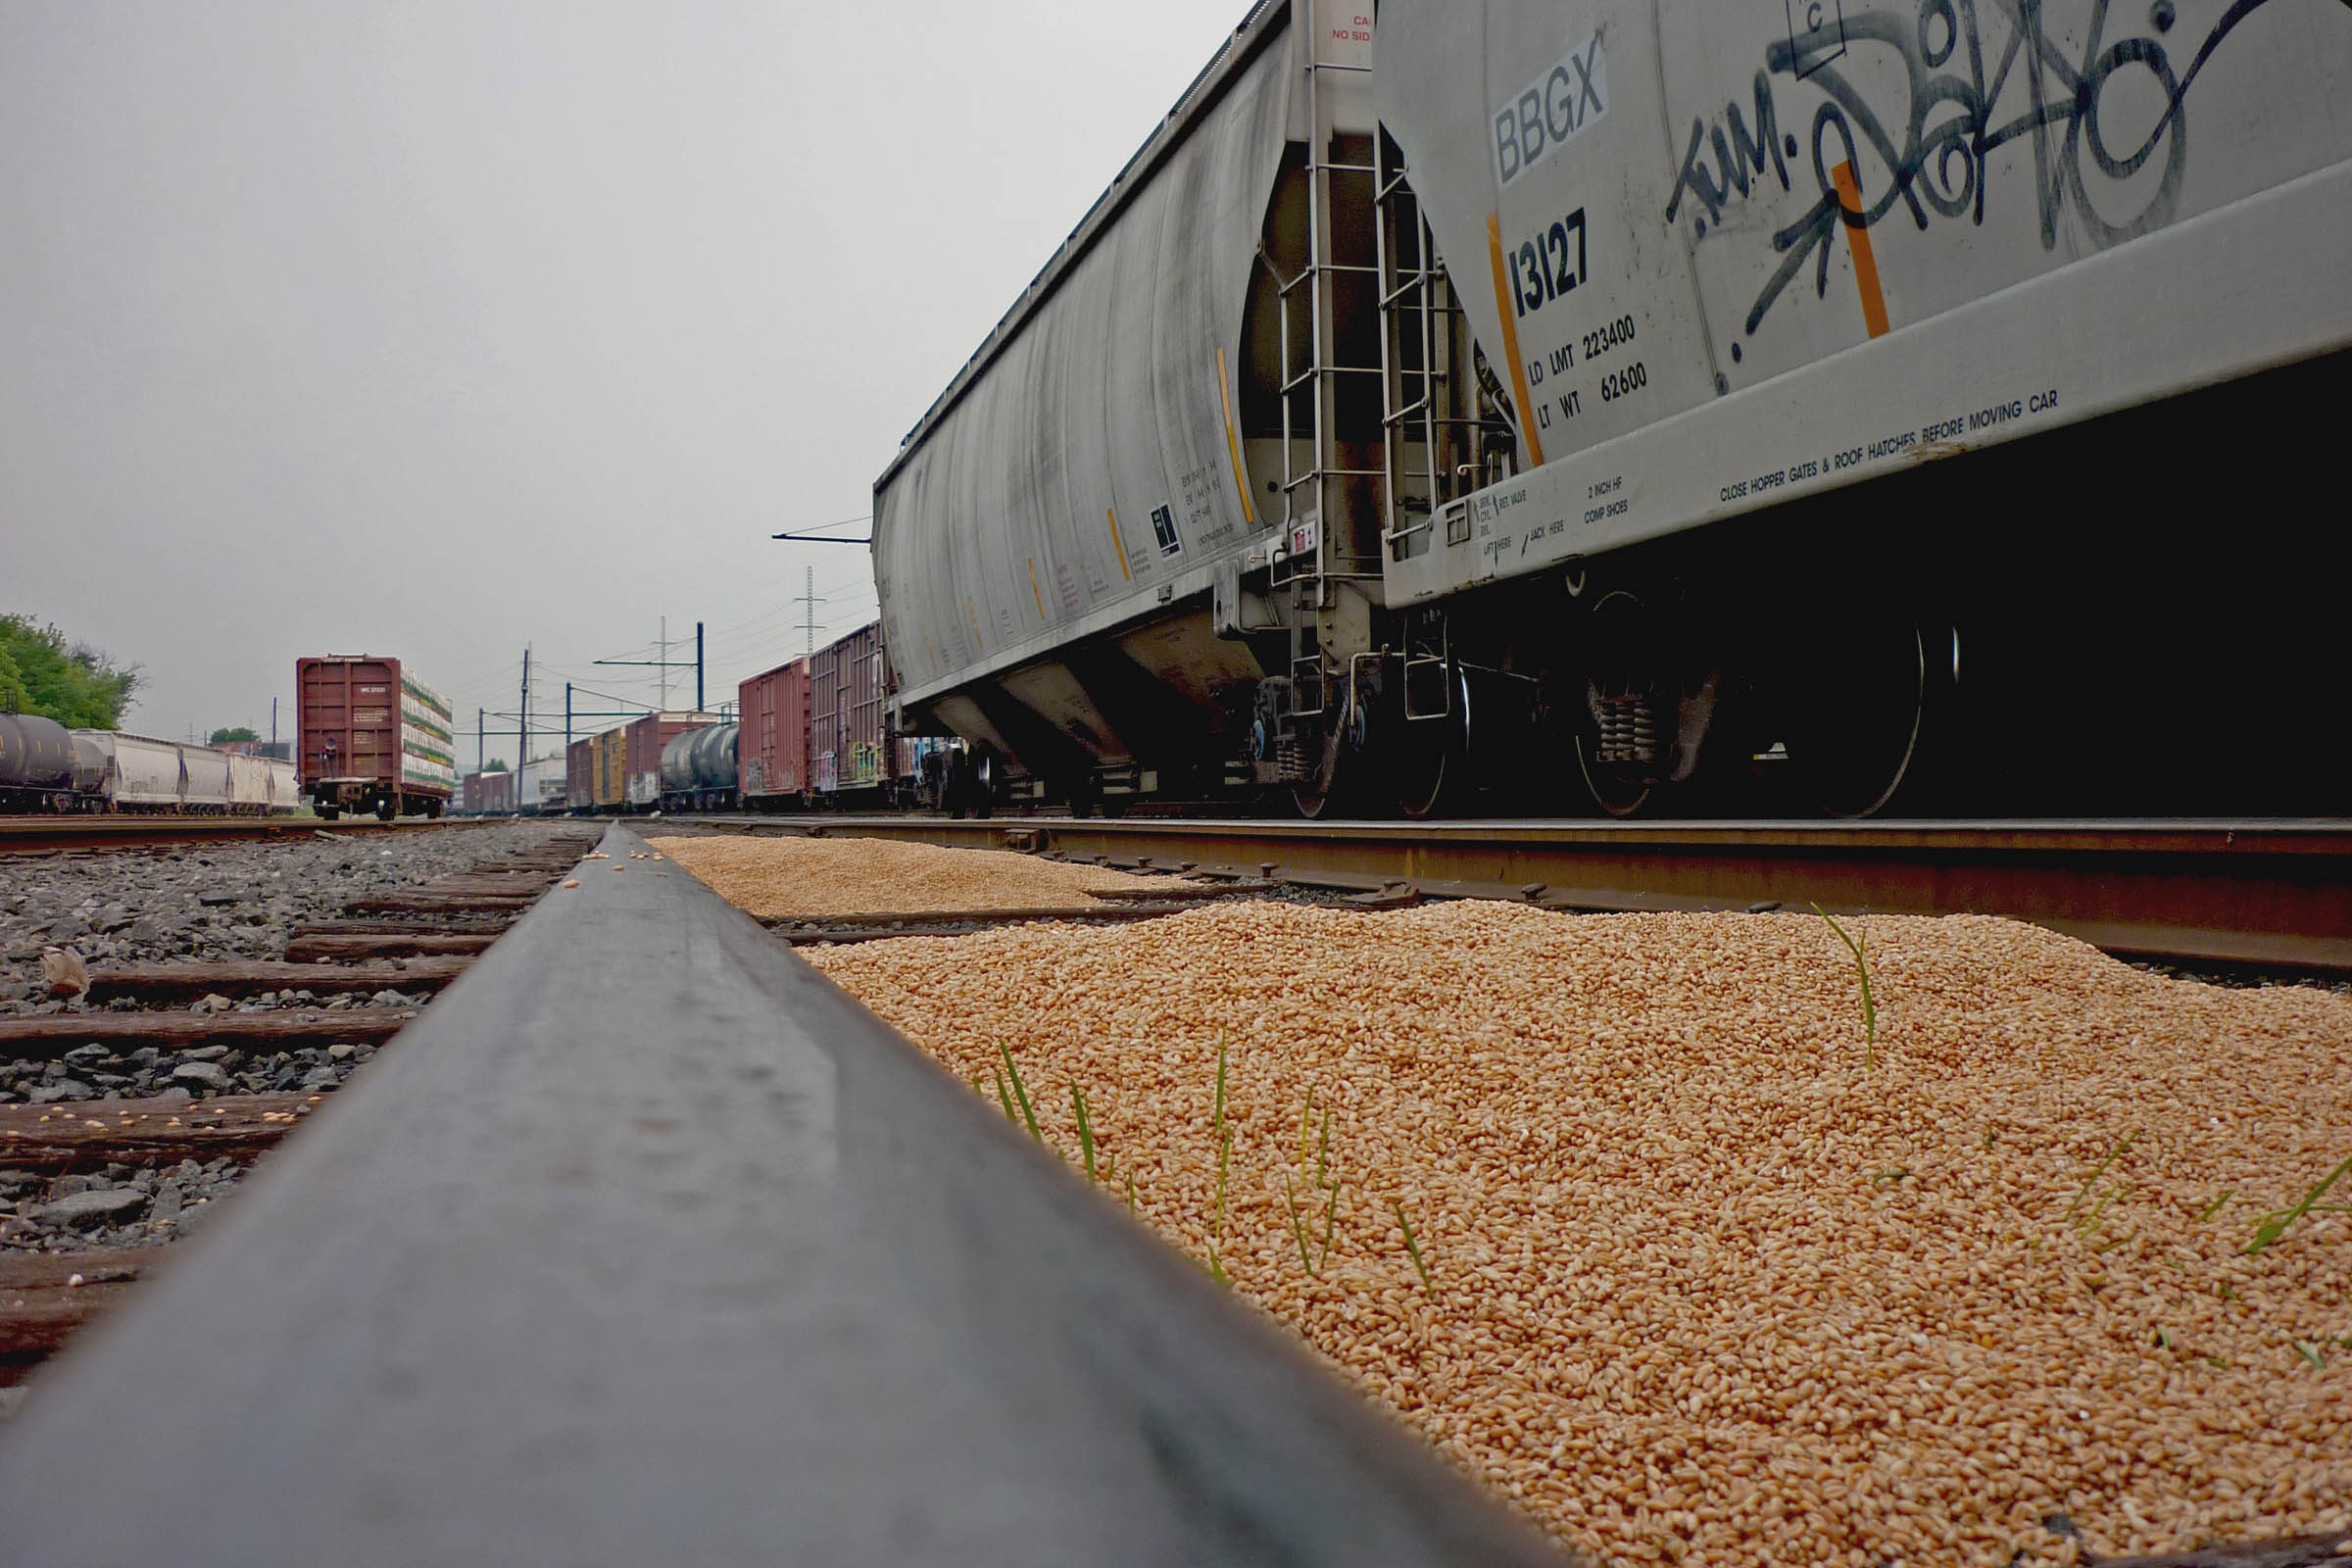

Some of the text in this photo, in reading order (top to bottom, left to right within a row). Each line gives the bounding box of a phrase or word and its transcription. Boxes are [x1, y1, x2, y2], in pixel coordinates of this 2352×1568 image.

[1333, 29, 1349, 39] NO
[1495, 37, 1603, 184] BBGX
[1509, 207, 1587, 318] 13127
[1528, 314, 1636, 386] LD LMT 223400
[1538, 362, 1647, 429] LT WT 62600
[1720, 389, 2058, 502] CLOSE HOPPER GATES & ROOF HATCHES BEFORE MOVING CAR
[1594, 479, 1611, 496] INCH
[1530, 519, 1564, 541] JACK HERE
[1584, 499, 1629, 524] COMP SHOES
[1498, 536, 1511, 550] HERE
